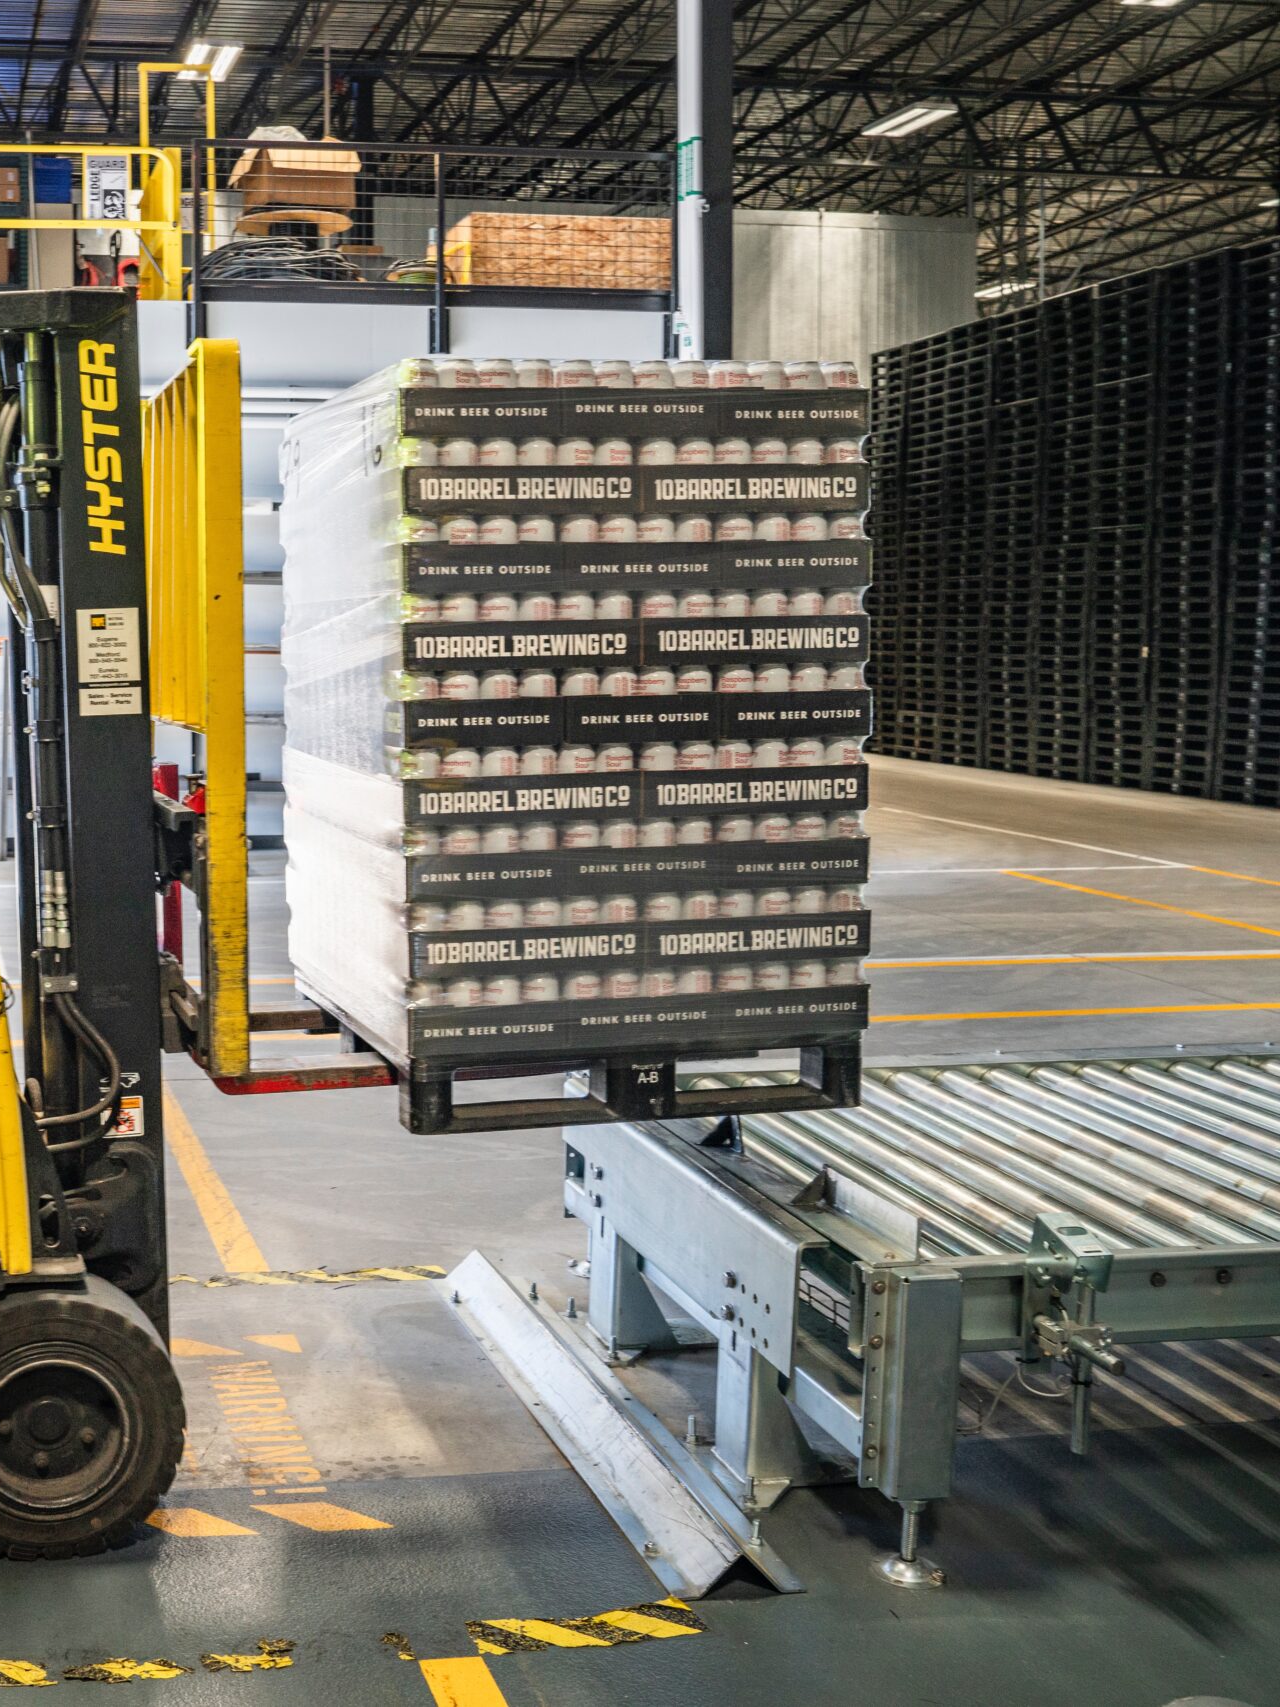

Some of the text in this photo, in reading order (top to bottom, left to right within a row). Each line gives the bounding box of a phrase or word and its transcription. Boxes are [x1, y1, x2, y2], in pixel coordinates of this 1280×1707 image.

[415, 406, 548, 417] DRINK BEER OUTSIDE
[576, 404, 705, 414] DRINK BEER OUTSIDE
[735, 409, 859, 419] DRINK BEER OUTSIDE
[78, 339, 127, 555] HYSTER
[581, 563, 709, 574] DRINK BEER OUTSIDE
[736, 557, 859, 568] DRINK BEER OUTSIDE
[419, 564, 552, 576] DRINK BEER OUTSIDE
[418, 714, 550, 728] DRINK BEER OUTSIDE
[581, 712, 709, 725] DRINK BEER OUTSIDE
[738, 708, 861, 721] DRINK BEER OUTSIDE
[580, 860, 707, 874] DRINK BEER OUTSIDE
[737, 859, 859, 873] DRINK BEER OUTSIDE
[422, 868, 553, 883] DRINK BEER OUTSIDE
[735, 1001, 858, 1017] DRINK BEER OUTSIDE
[581, 1010, 707, 1026] DRINK BEER OUTSIDE
[424, 1023, 554, 1038] DRINK BEER OUTSIDE
[637, 1072, 659, 1084] A-B
[207, 1360, 328, 1496] WARNING!
